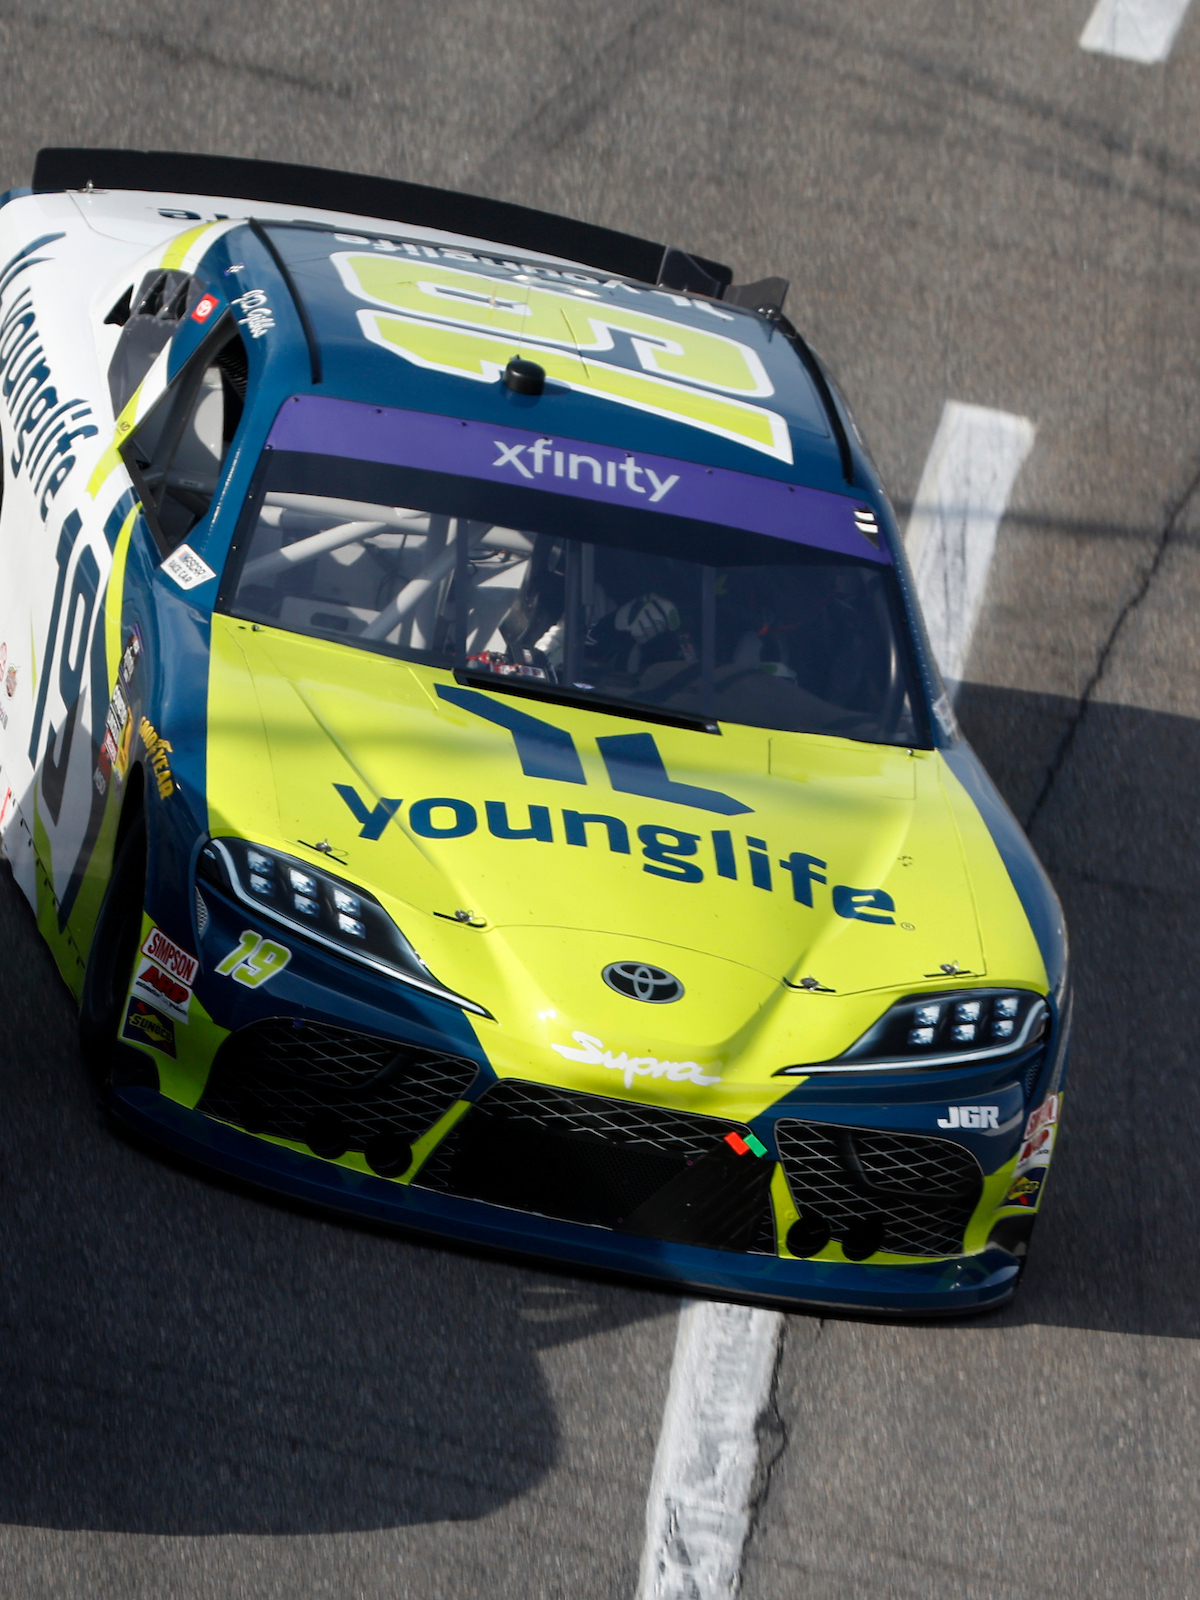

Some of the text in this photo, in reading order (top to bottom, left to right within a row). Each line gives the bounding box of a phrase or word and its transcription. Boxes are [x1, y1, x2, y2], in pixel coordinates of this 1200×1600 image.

[329, 250, 793, 465] 19
[492, 437, 680, 502] xfinity
[28, 508, 100, 826] 19
[332, 782, 897, 926] younglife
[139, 965, 189, 1005] ARP
[147, 933, 195, 982] SIMPSON
[214, 929, 292, 989] 19
[131, 1014, 173, 1043] SUNOCO
[551, 1030, 722, 1090] Supra
[937, 1106, 1000, 1129] JGR
